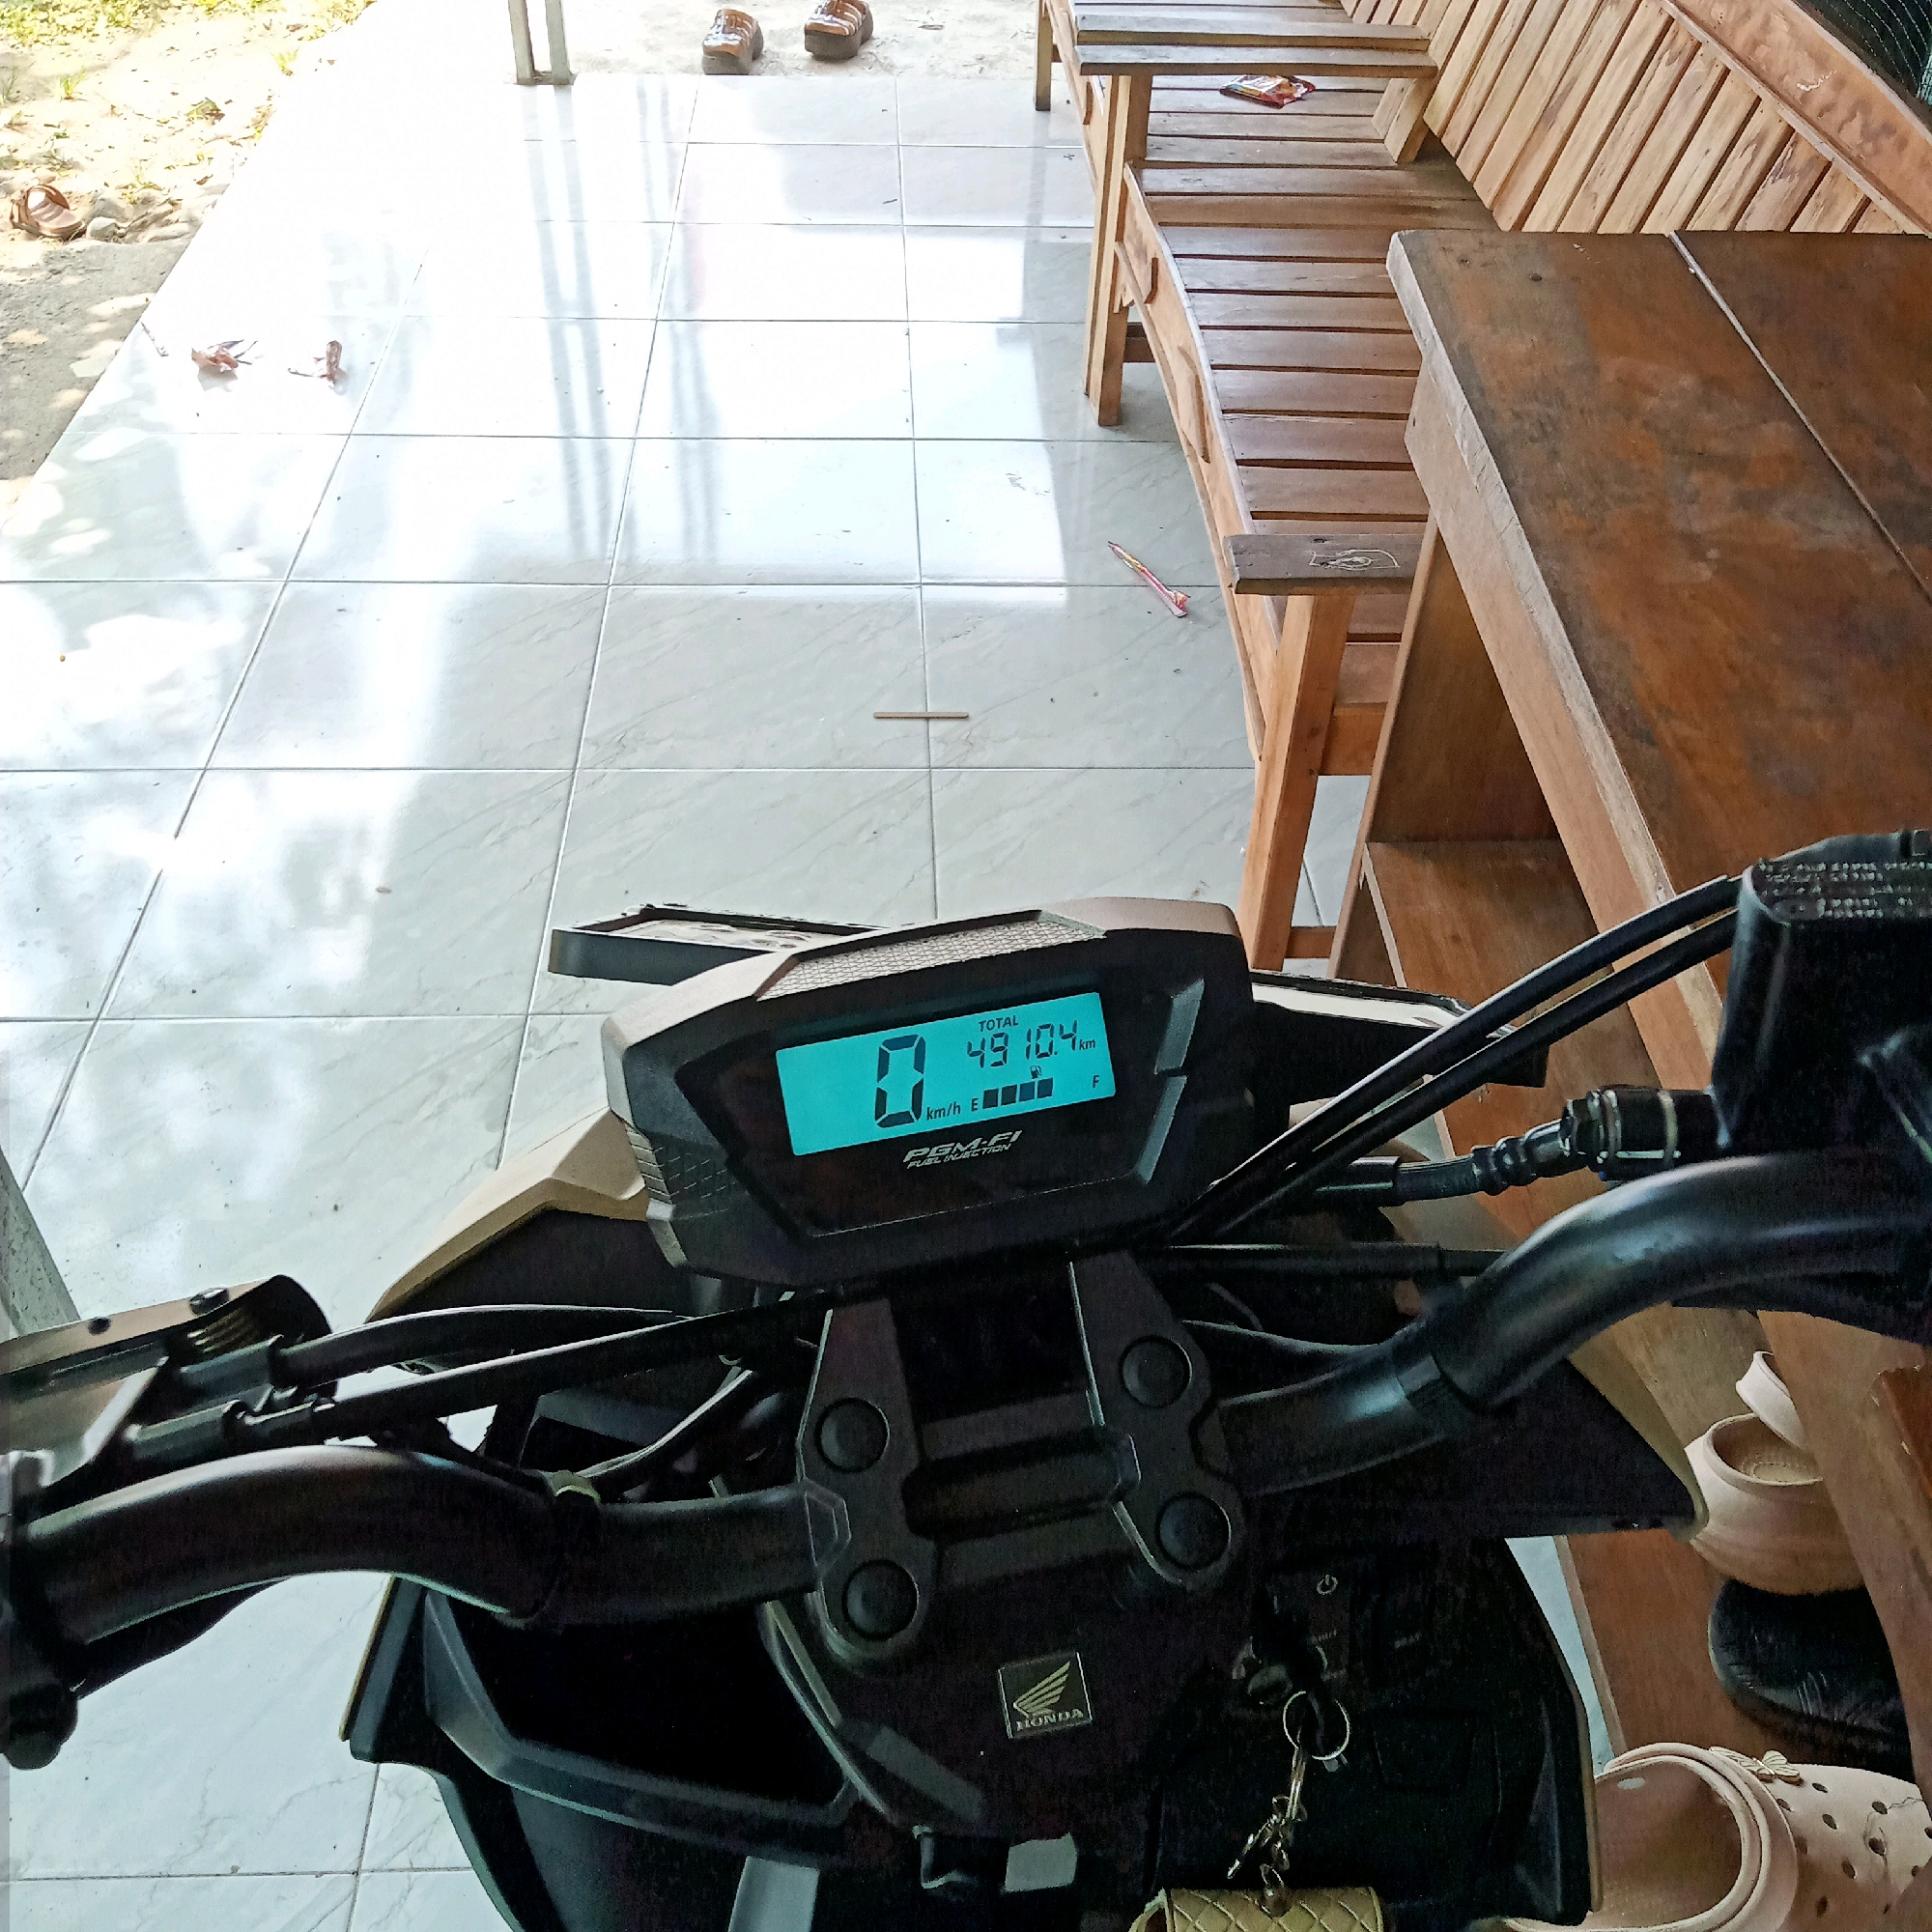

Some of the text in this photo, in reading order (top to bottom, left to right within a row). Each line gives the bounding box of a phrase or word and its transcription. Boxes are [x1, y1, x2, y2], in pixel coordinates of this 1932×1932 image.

[979, 1015, 1019, 1032] TOTAL
[967, 1020, 1096, 1068] 4910.4 km
[874, 1034, 961, 1128] 0 km/h
[1093, 1075, 1099, 1089] F
[971, 1097, 979, 1112] E
[907, 1143, 1011, 1169] FUEL INJECTION
[1016, 1708, 1084, 1732] HONDA
